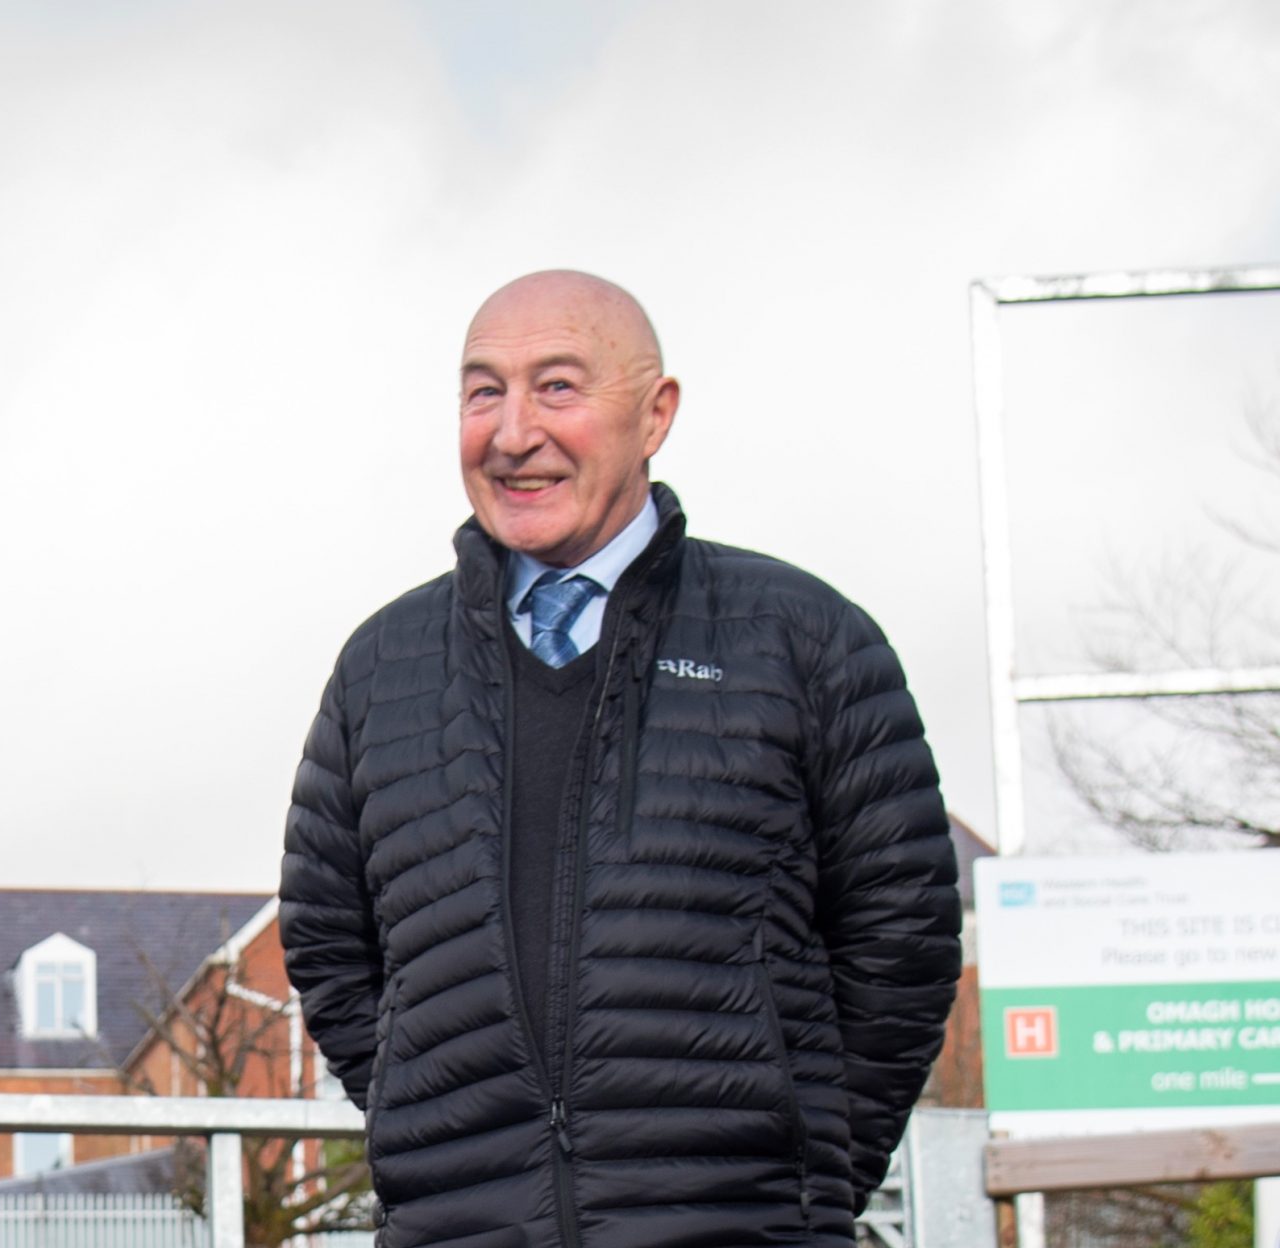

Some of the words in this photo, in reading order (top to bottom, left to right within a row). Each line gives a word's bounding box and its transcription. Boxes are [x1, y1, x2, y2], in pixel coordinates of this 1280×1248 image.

[677, 659, 723, 681] Rab
[1120, 916, 1168, 937] THIS
[1176, 915, 1224, 936] SITE
[1233, 914, 1254, 935] IS
[1102, 948, 1166, 966] Please
[1174, 952, 1200, 967] go
[1207, 948, 1228, 963] to
[1147, 1001, 1240, 1024] OMAGH
[1093, 1031, 1114, 1053] &
[1118, 1028, 1234, 1051] PRIMARY
[1151, 1072, 1196, 1091] one
[1200, 1067, 1248, 1089] mile
